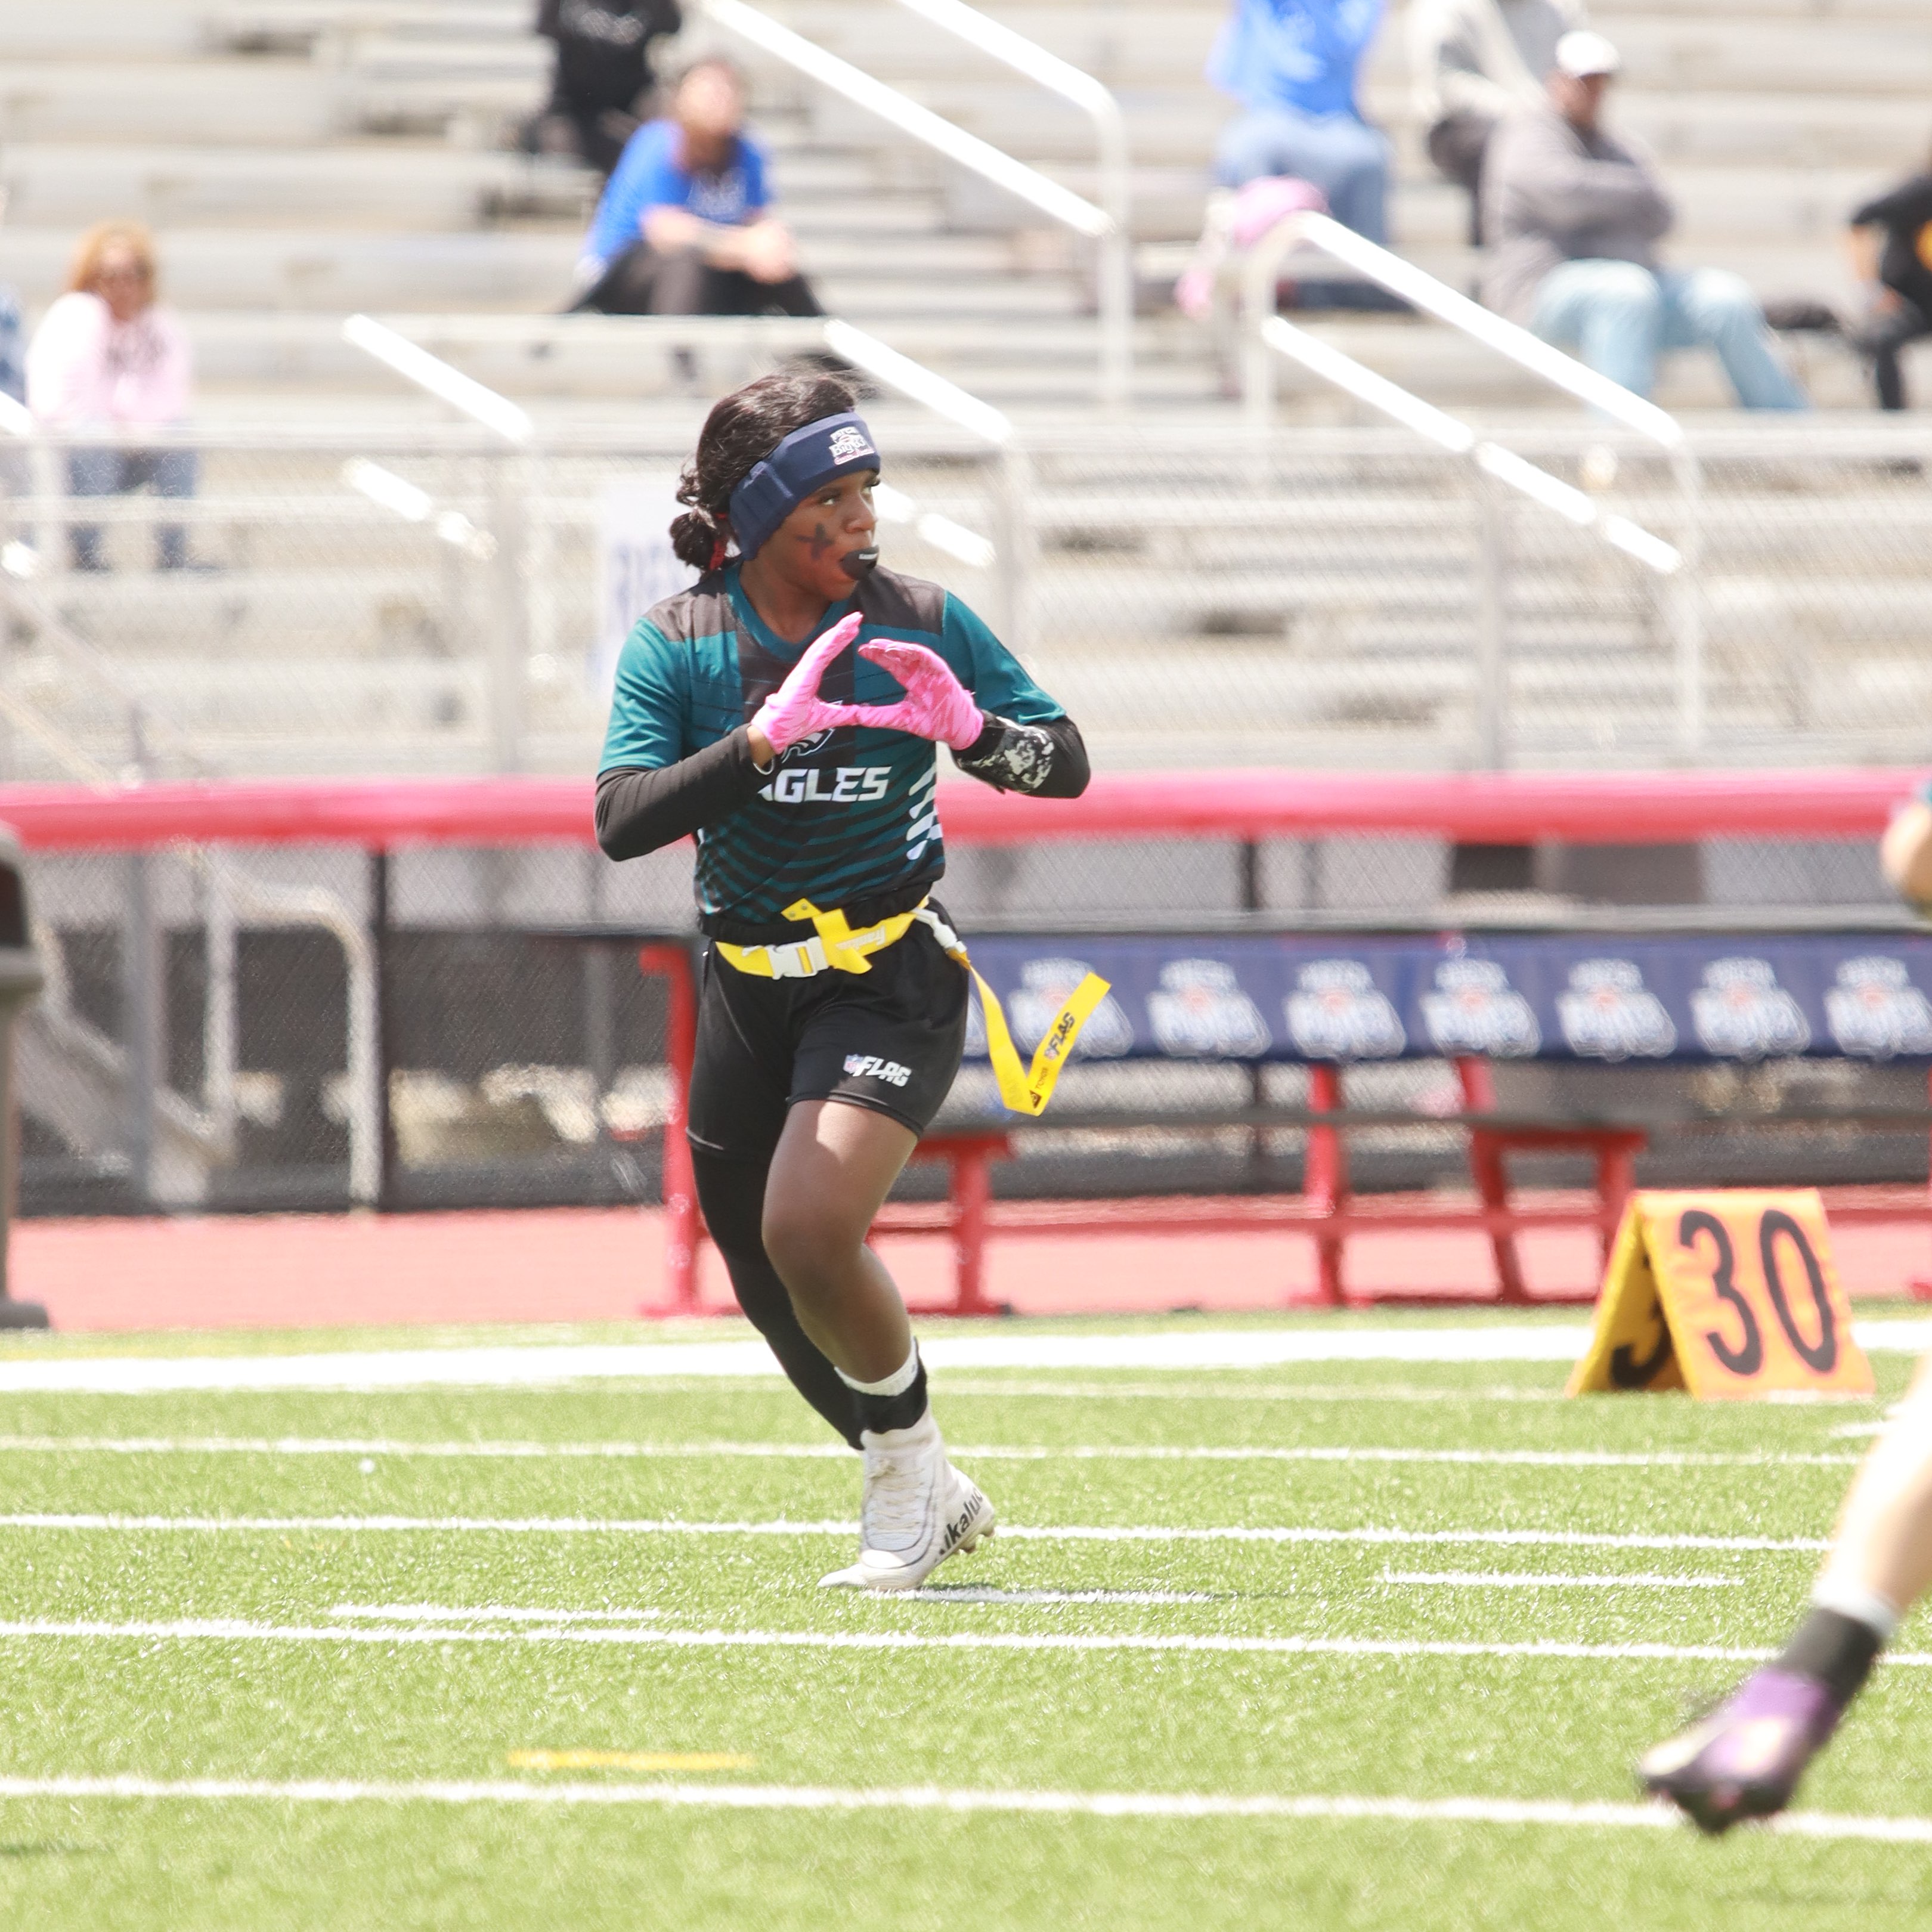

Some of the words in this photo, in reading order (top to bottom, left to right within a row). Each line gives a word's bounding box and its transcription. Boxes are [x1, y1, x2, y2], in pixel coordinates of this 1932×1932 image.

[829, 441, 854, 457] Big
[757, 766, 893, 804] GLES
[852, 1055, 912, 1088] FLAG
[1679, 1208, 1837, 1376] 30
